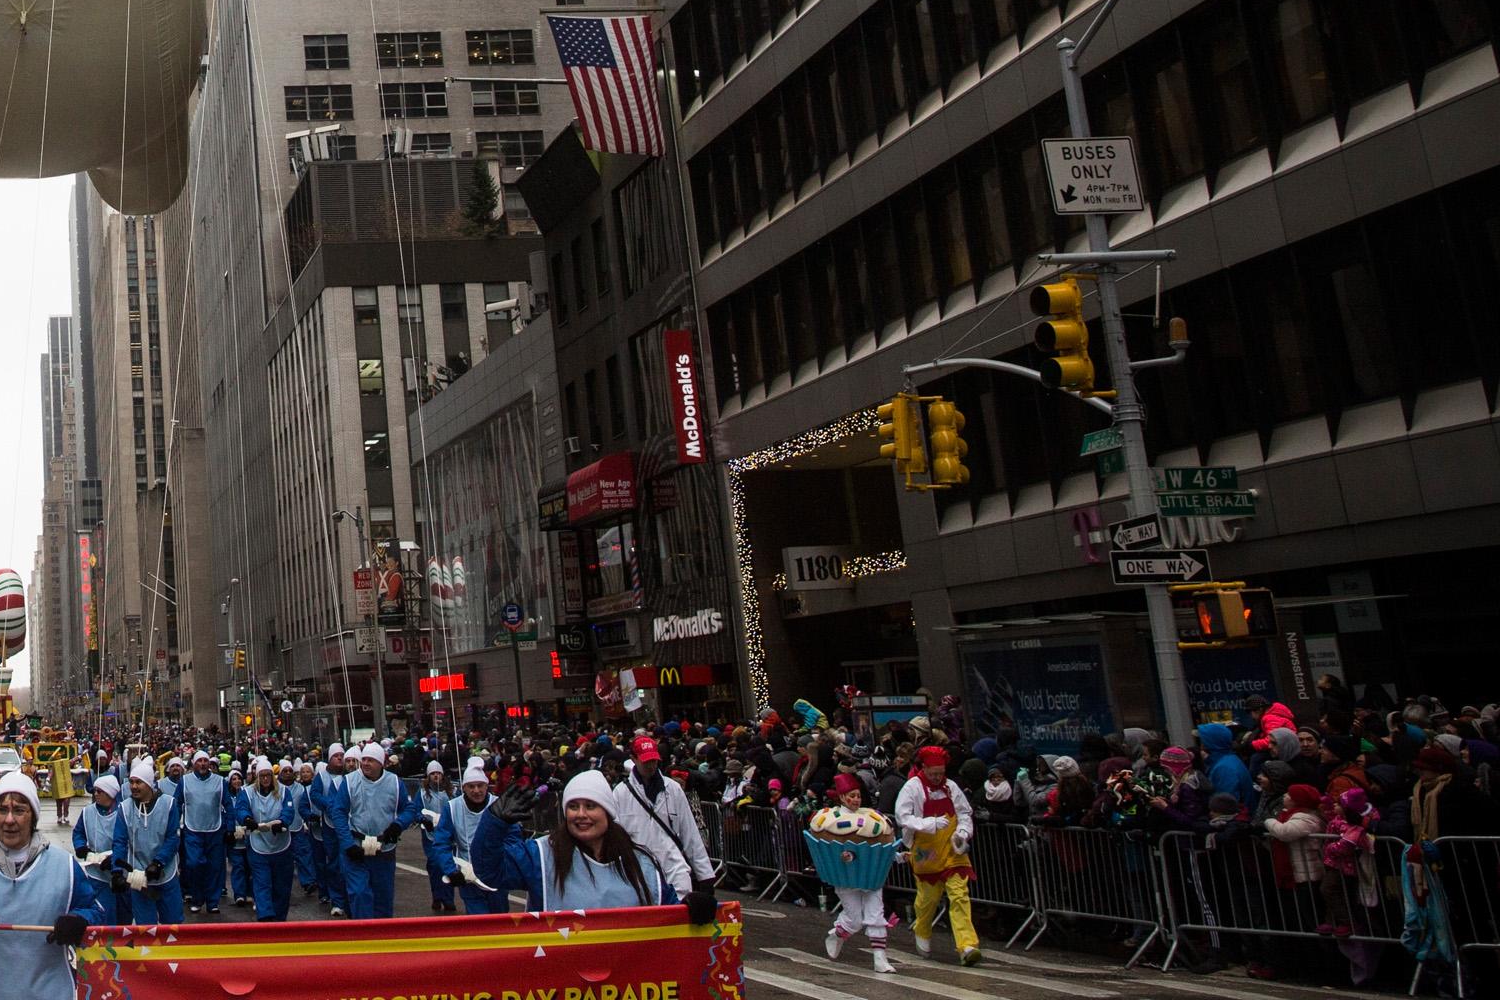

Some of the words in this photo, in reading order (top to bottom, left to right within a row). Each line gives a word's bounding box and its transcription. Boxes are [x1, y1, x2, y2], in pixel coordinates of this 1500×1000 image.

[1061, 145, 1116, 160] BUSES
[1071, 164, 1112, 179] ONLY
[1086, 184, 1130, 193] 4PM-7PM
[1083, 195, 1102, 205] MON
[1122, 195, 1138, 203] FRI
[675, 353, 702, 458] McDonald's
[599, 479, 615, 489] New
[1169, 470, 1183, 488] W
[1192, 470, 1217, 488] 46
[1221, 469, 1233, 479] ST
[1158, 495, 1201, 508] LITTLE
[1206, 494, 1254, 507] BRAZIL
[1117, 531, 1133, 546] ONE
[1138, 524, 1155, 538] WAY
[795, 555, 843, 582] 1180
[1126, 561, 1155, 574] ONE
[1165, 560, 1194, 573] WAY
[653, 607, 724, 643] McDonald's
[1285, 631, 1311, 700] Newsstand
[1187, 679, 1222, 694] You'd
[1225, 678, 1268, 693] better
[886, 695, 913, 705] TITAN
[1016, 689, 1045, 711] You'd
[1045, 688, 1081, 711] better
[564, 981, 678, 1000] PARADE
